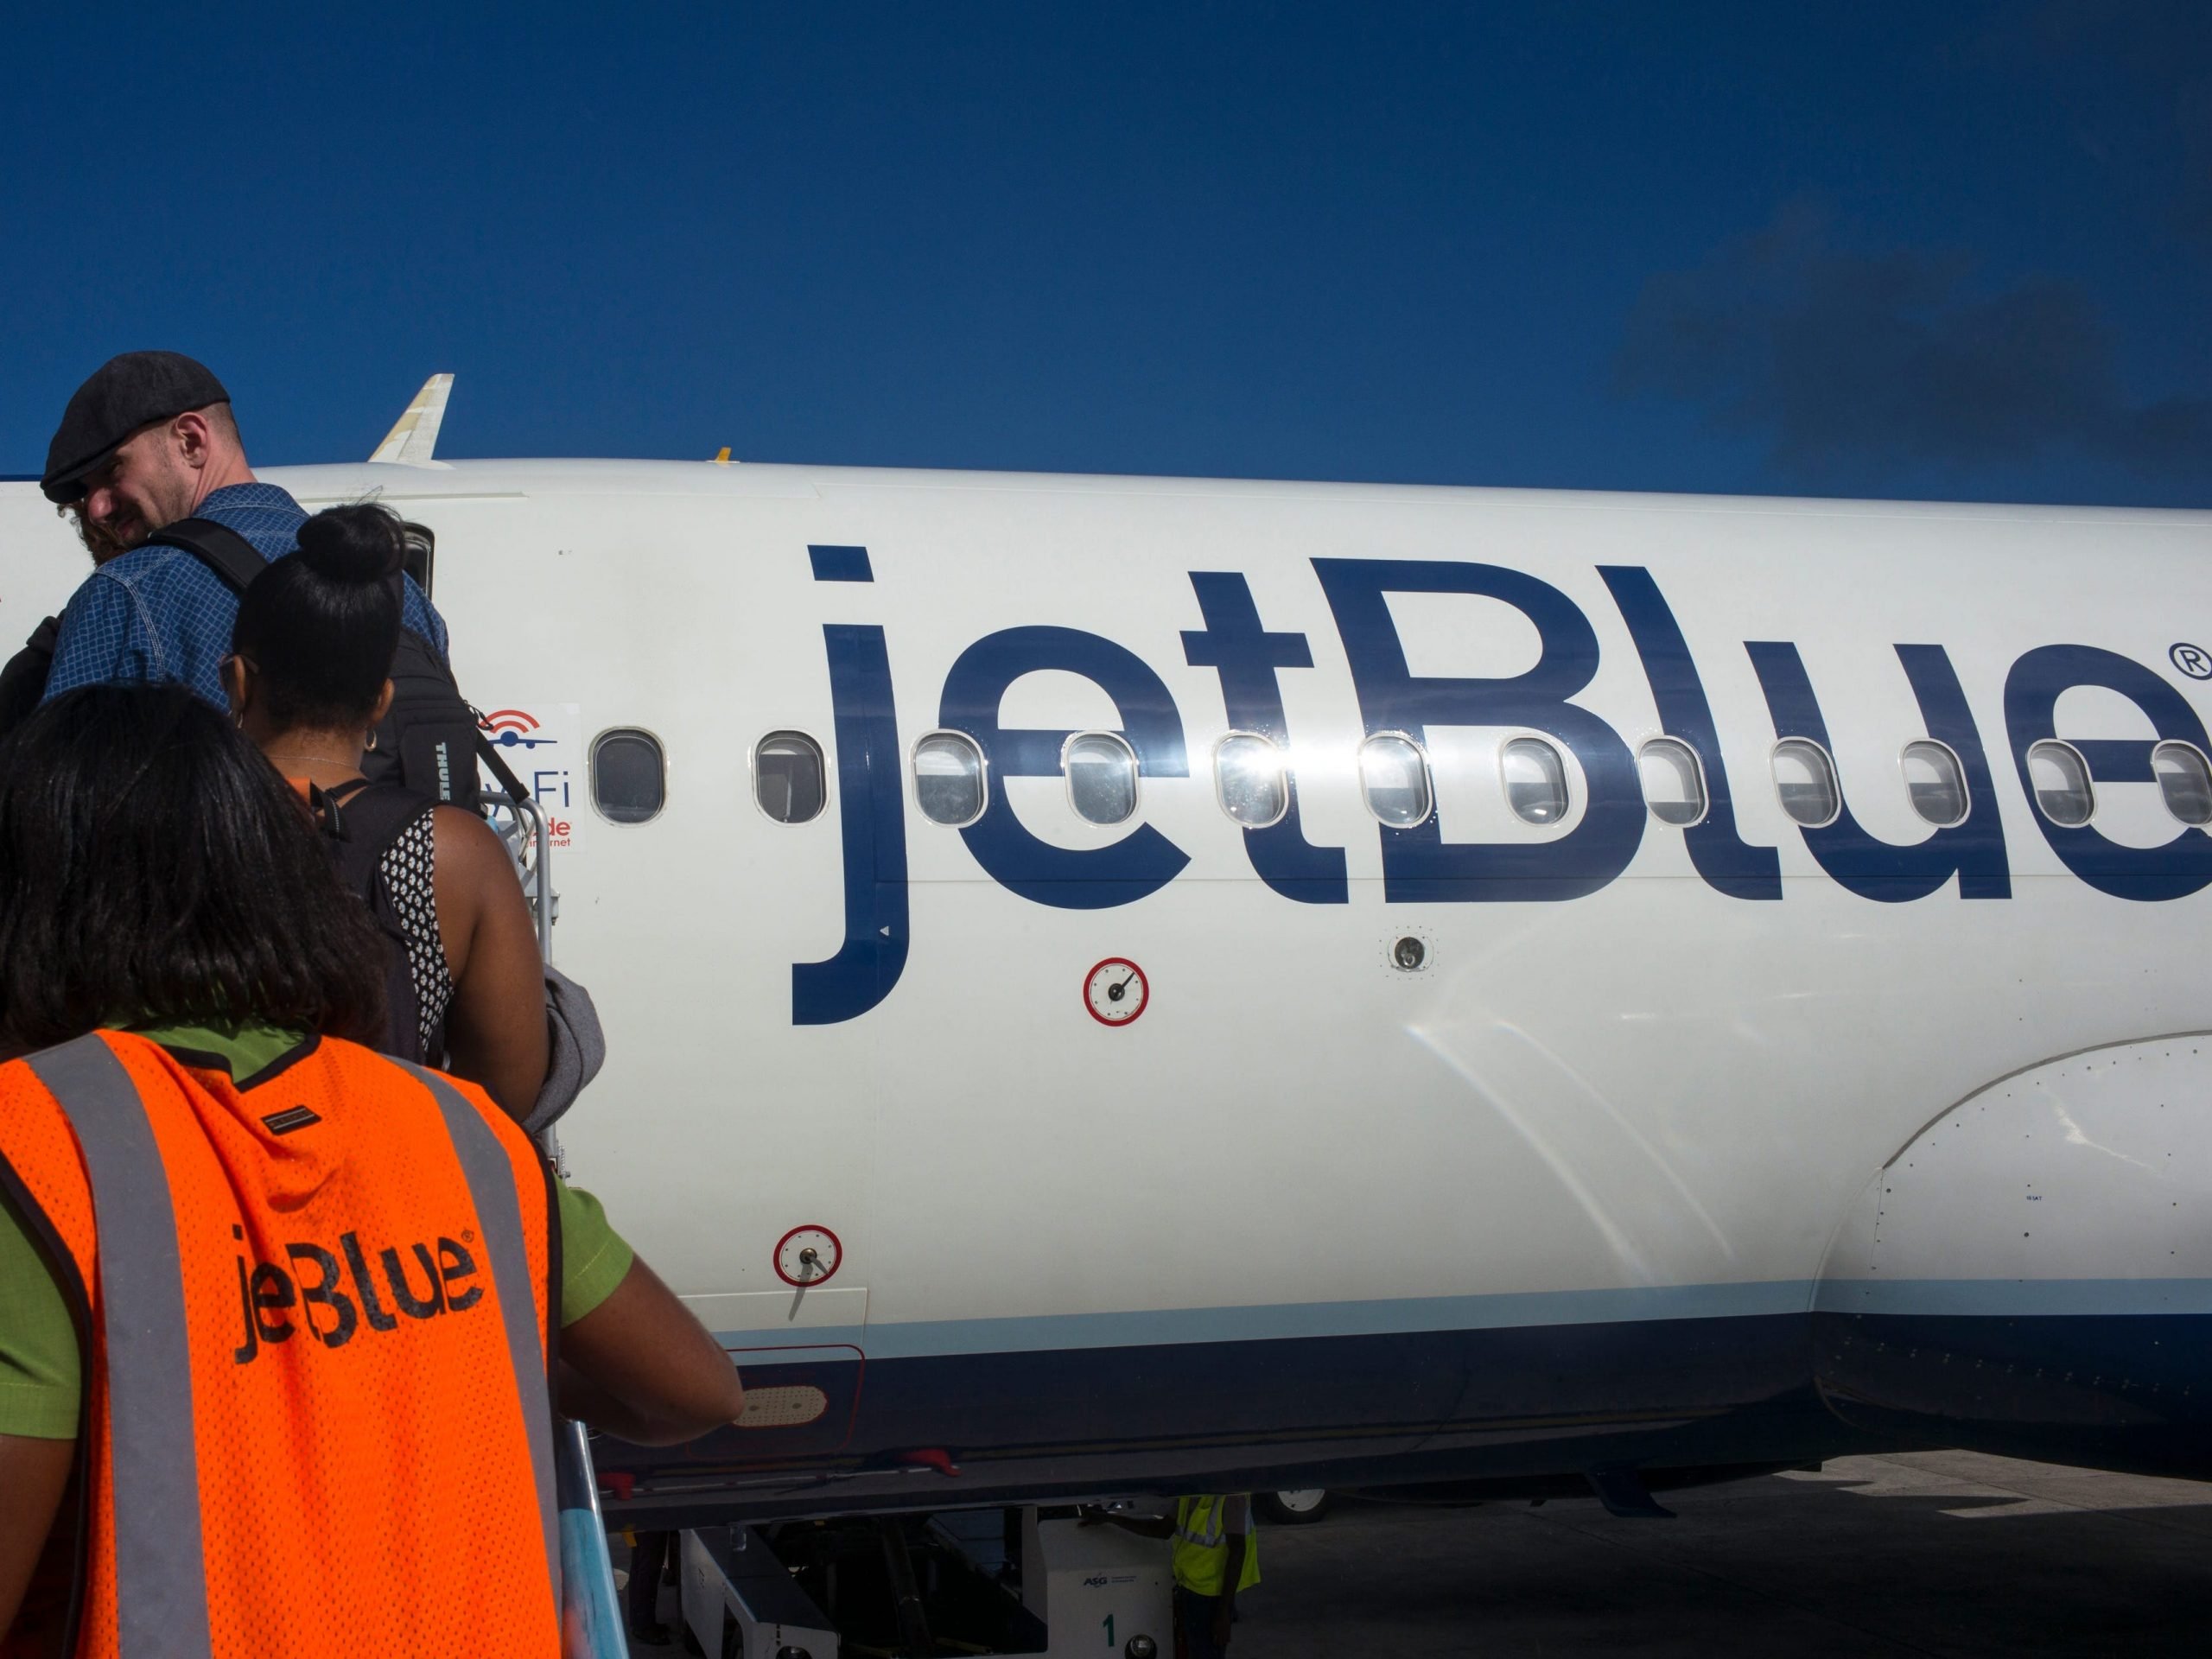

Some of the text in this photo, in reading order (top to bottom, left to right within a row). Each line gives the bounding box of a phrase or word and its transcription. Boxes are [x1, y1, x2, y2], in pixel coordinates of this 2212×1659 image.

[435, 742, 450, 801] THULE
[1084, 1575, 1108, 1587] ASG
[1103, 1613, 1115, 1648] 1
